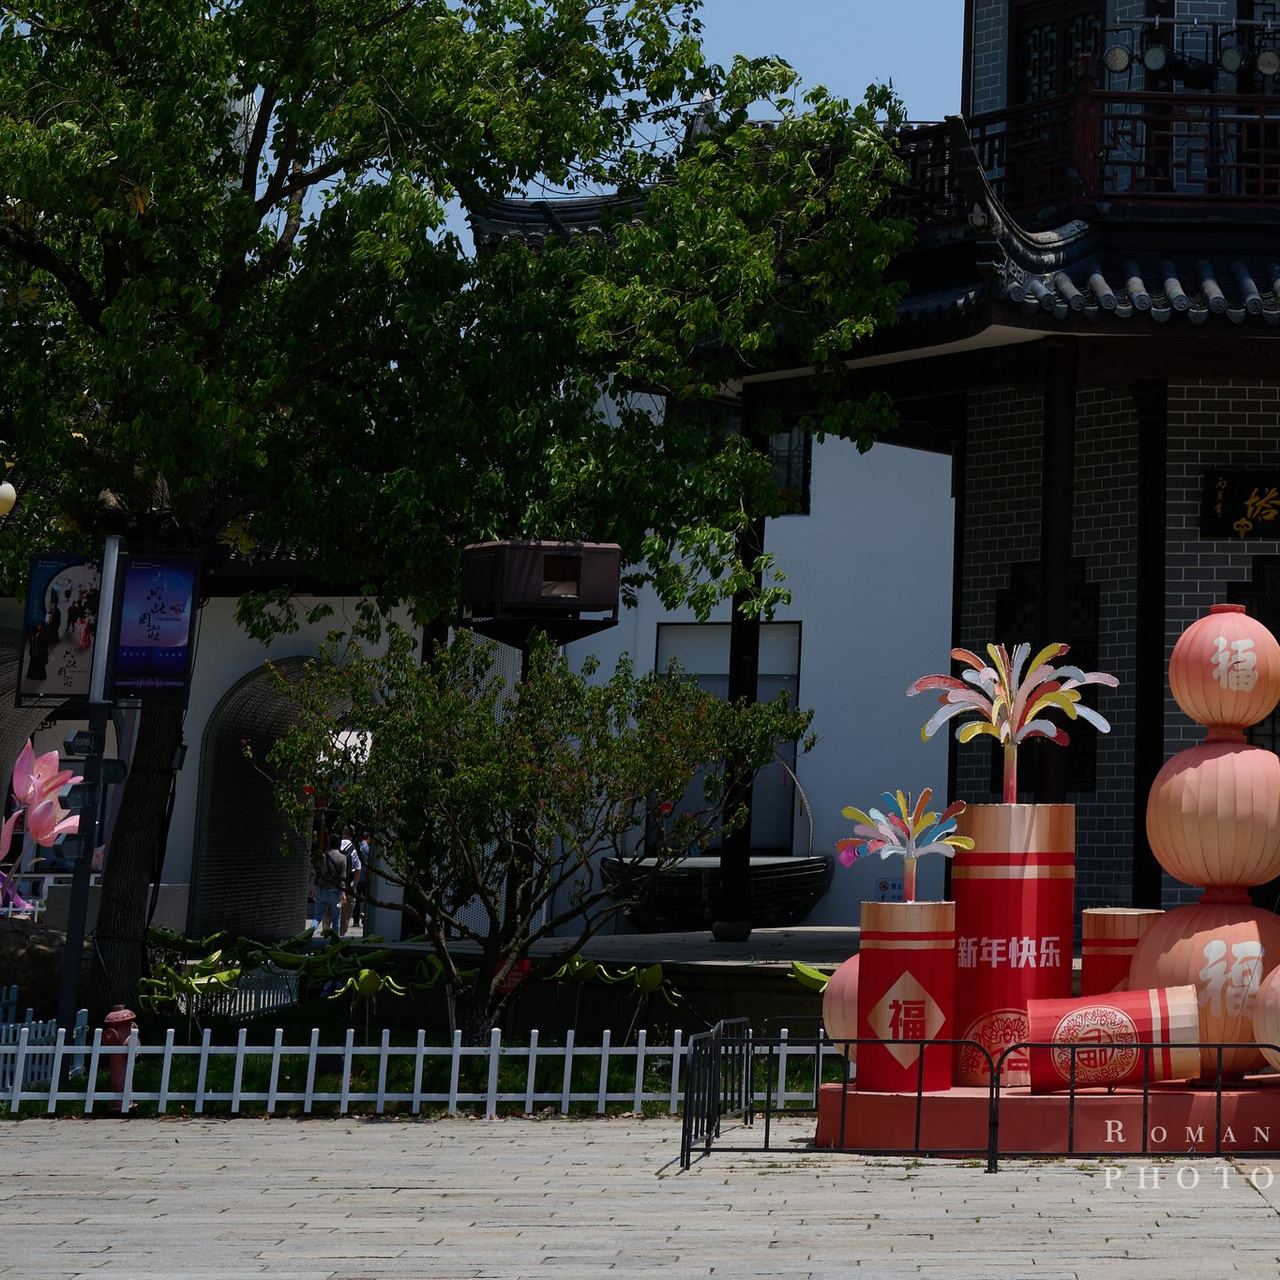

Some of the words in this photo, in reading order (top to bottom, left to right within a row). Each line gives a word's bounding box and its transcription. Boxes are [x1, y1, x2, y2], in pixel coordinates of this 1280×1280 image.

[1211, 636, 1259, 694] 福
[957, 935, 1061, 969] 新年快乐
[1197, 939, 1265, 1018] 福
[888, 999, 927, 1040] 福
